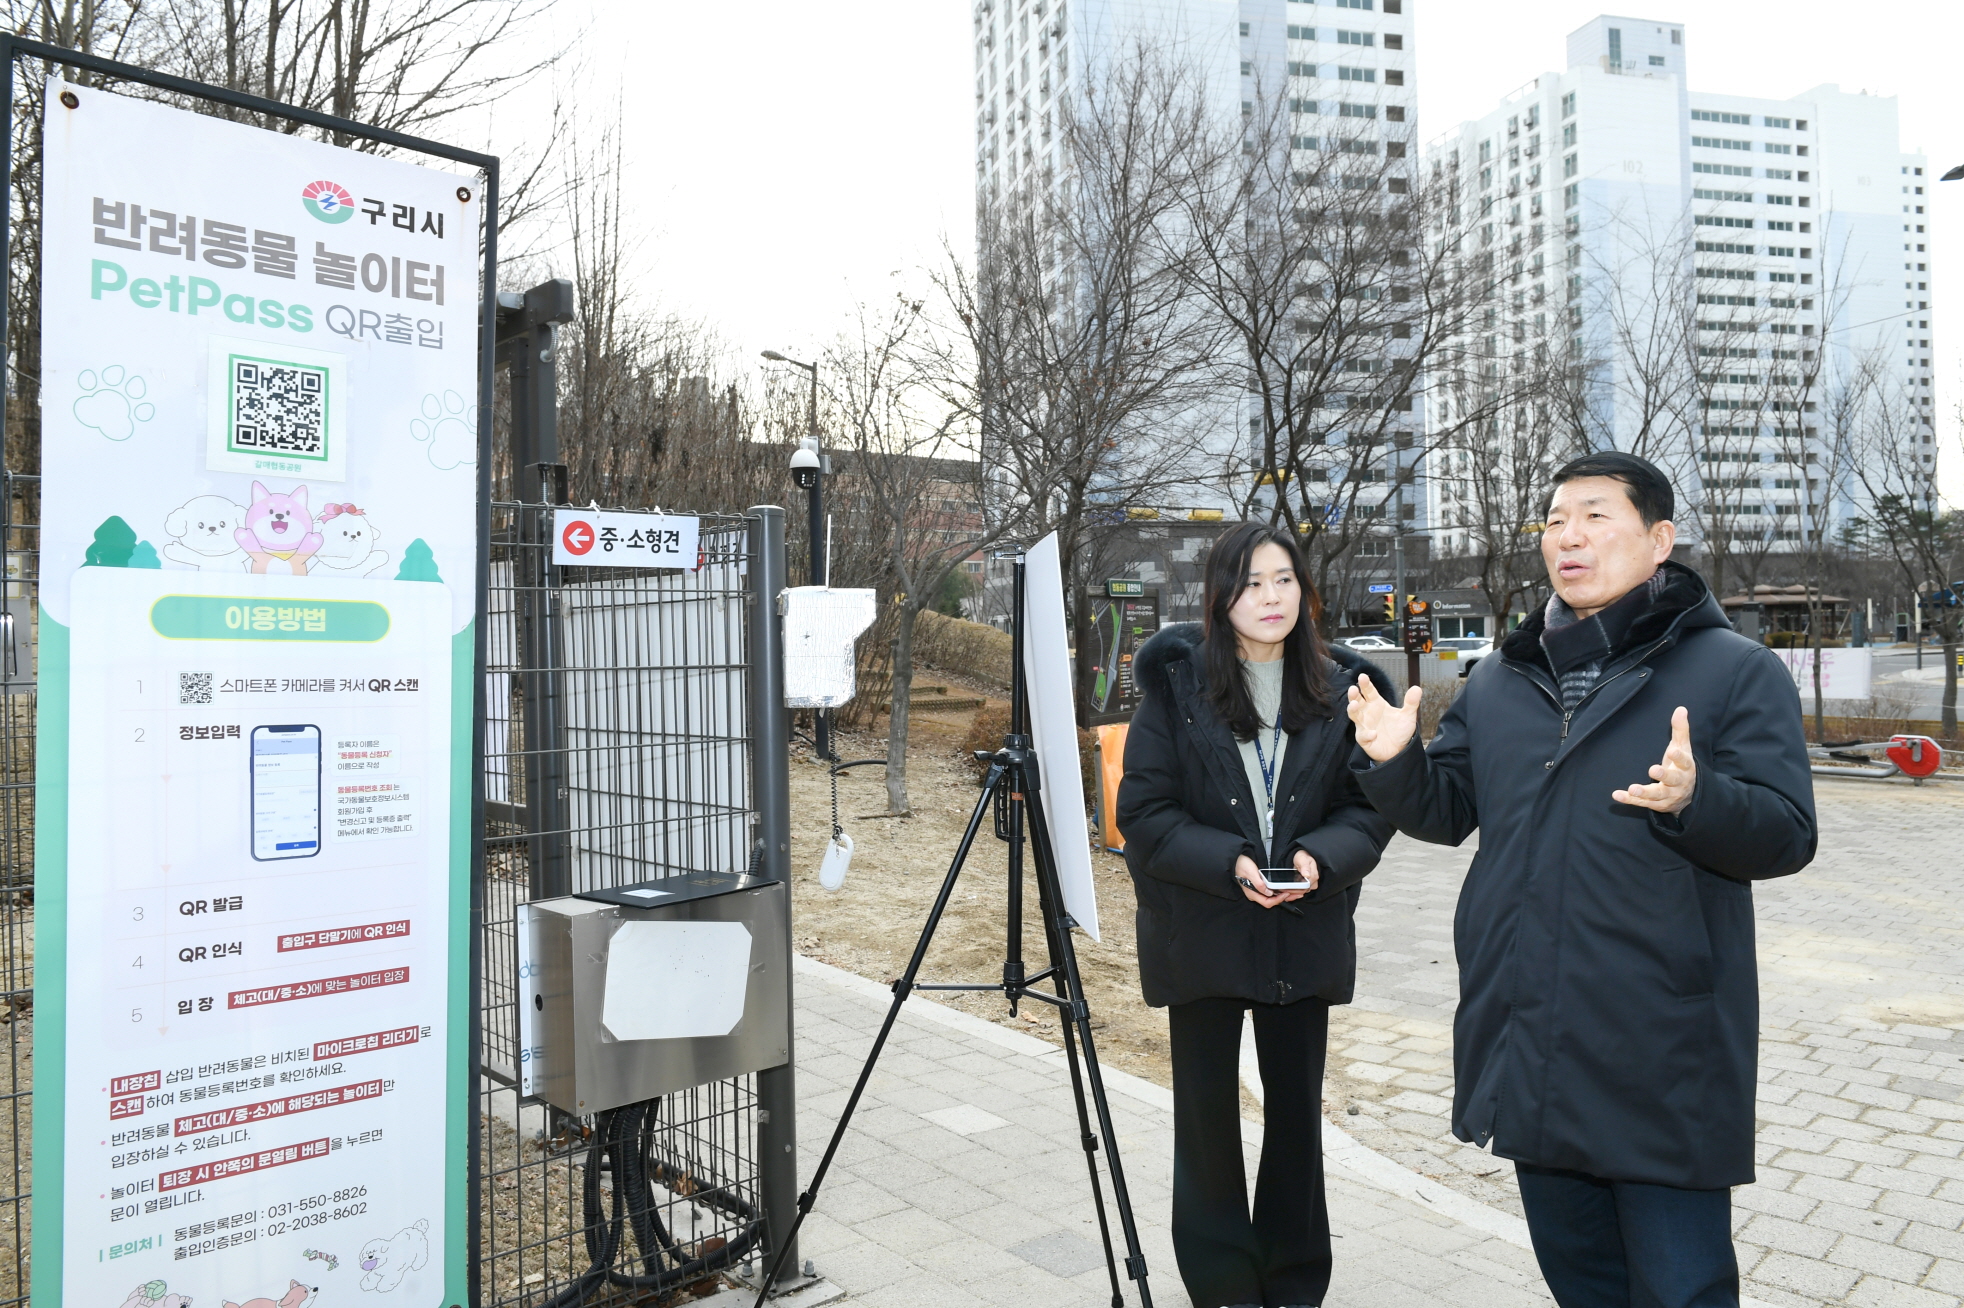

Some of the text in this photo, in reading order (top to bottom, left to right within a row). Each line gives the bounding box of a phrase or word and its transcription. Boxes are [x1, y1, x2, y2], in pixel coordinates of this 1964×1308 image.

[1622, 160, 1644, 174] 102
[361, 198, 444, 239] 구리시
[92, 196, 444, 306] 반려동물 놀이터
[91, 258, 444, 350] PetPass QR출입
[255, 460, 302, 472] 갈매협동공원
[600, 526, 680, 554] 중·소형견
[225, 606, 326, 632] 이용방법
[137, 678, 418, 694] 1 스마트폰 카메라를 켜서 QR 스캔
[134, 725, 241, 742] 2 정보입력
[360, 740, 380, 748] 이름은
[338, 762, 364, 770] 이름으로
[338, 784, 378, 794] 동물등록번호
[338, 794, 410, 804] 국가동물보호정보시스템
[338, 806, 364, 816] 회원가입
[376, 815, 395, 824] 등록증
[338, 824, 414, 837] 메뉴에서 확인 가능합니다.
[133, 896, 243, 922] 3 QR 발급
[282, 922, 406, 948] 출입구 단말기에 QR 인식
[132, 942, 242, 970] 4 QR 인식
[233, 969, 405, 1006] 체고(대/중·소)에 맞는 놀이터 입장
[131, 1008, 142, 1022] 5
[114, 1074, 158, 1094] 내장칩
[165, 1068, 194, 1085] 삽입
[198, 1055, 266, 1078] 반려동물은
[270, 1048, 309, 1065] 비치된
[316, 1035, 379, 1059] 마이크로칩
[112, 1062, 347, 1116] 스캔 하여 동물등록번호를 확인하세요.
[112, 1122, 170, 1147] 반려동물
[178, 1101, 285, 1134] 체고(대/중·소)에
[288, 1090, 340, 1111] 해당되는
[111, 1128, 252, 1170] 입장하실 수 있습니다.
[110, 1178, 154, 1200] 놀이터
[162, 1170, 193, 1189] 퇴장
[195, 1166, 209, 1181] 시
[213, 1156, 255, 1178] 안쪽의
[258, 1147, 298, 1168] 문열림
[346, 1128, 384, 1148] 누르면
[110, 1189, 205, 1222] 문이 열립니다.
[174, 1210, 257, 1242] 동물등록문의
[268, 1185, 368, 1220] 031-550-8826
[174, 1229, 257, 1261] 출입인증문의
[268, 1202, 368, 1238] 02-2038-8602
[109, 1237, 152, 1260] 문의처
